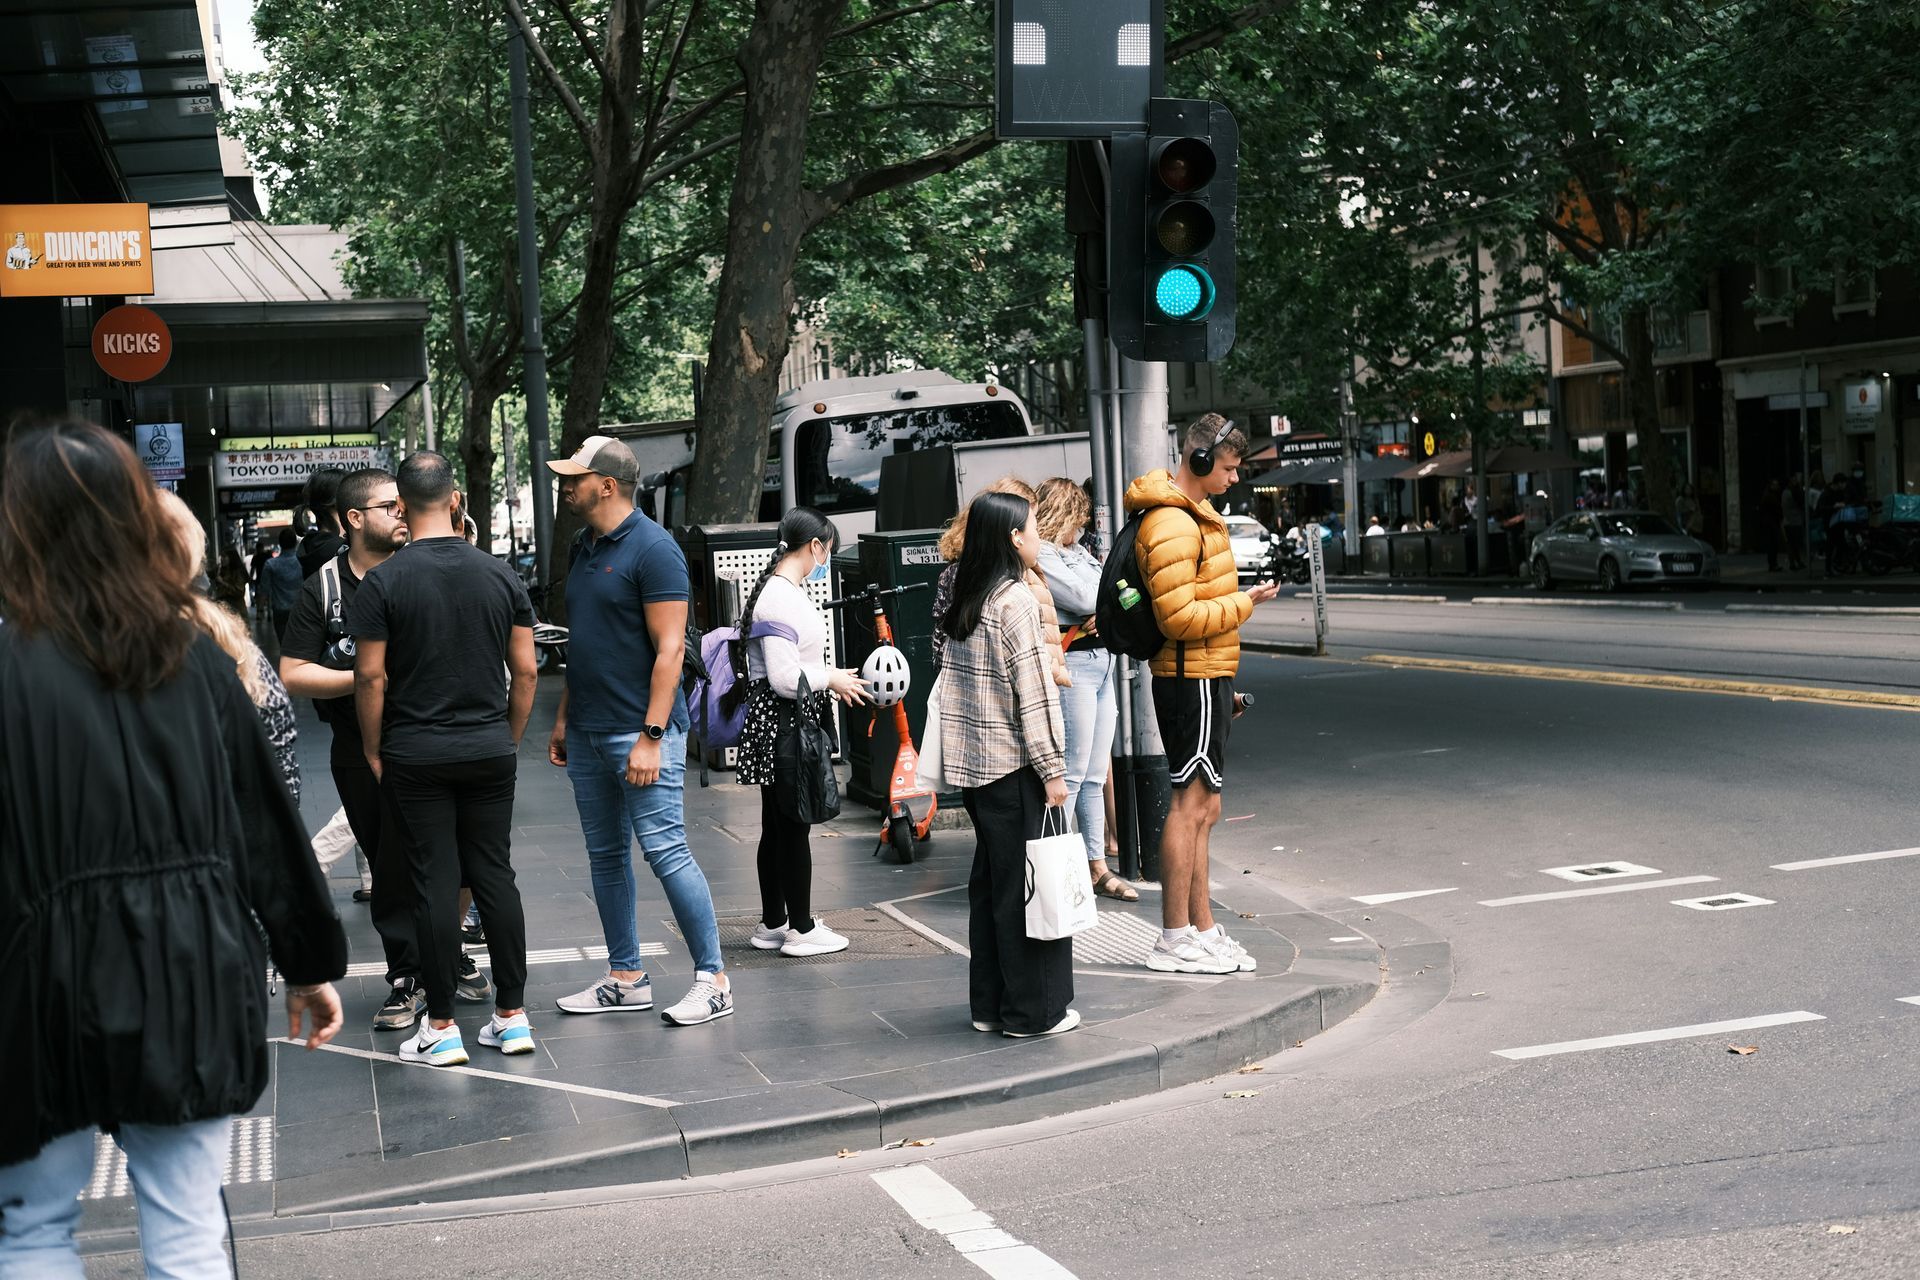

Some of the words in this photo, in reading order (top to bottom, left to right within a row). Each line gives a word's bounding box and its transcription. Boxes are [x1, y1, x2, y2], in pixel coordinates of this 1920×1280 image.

[1026, 79, 1135, 114] WAIT
[44, 230, 141, 261] DUNCAN'S
[103, 333, 161, 354] KICKS
[1282, 444, 1300, 452] JETS
[1300, 442, 1318, 451] HAIR
[1318, 441, 1343, 450] STYLIS
[228, 464, 279, 477] TOKYO
[906, 547, 929, 556] SIGNAL
[930, 546, 940, 554] FA
[920, 555, 930, 563] 13
[932, 554, 940, 563] 11
[1310, 527, 1321, 576] KEEP
[1315, 583, 1326, 635] LEFT
